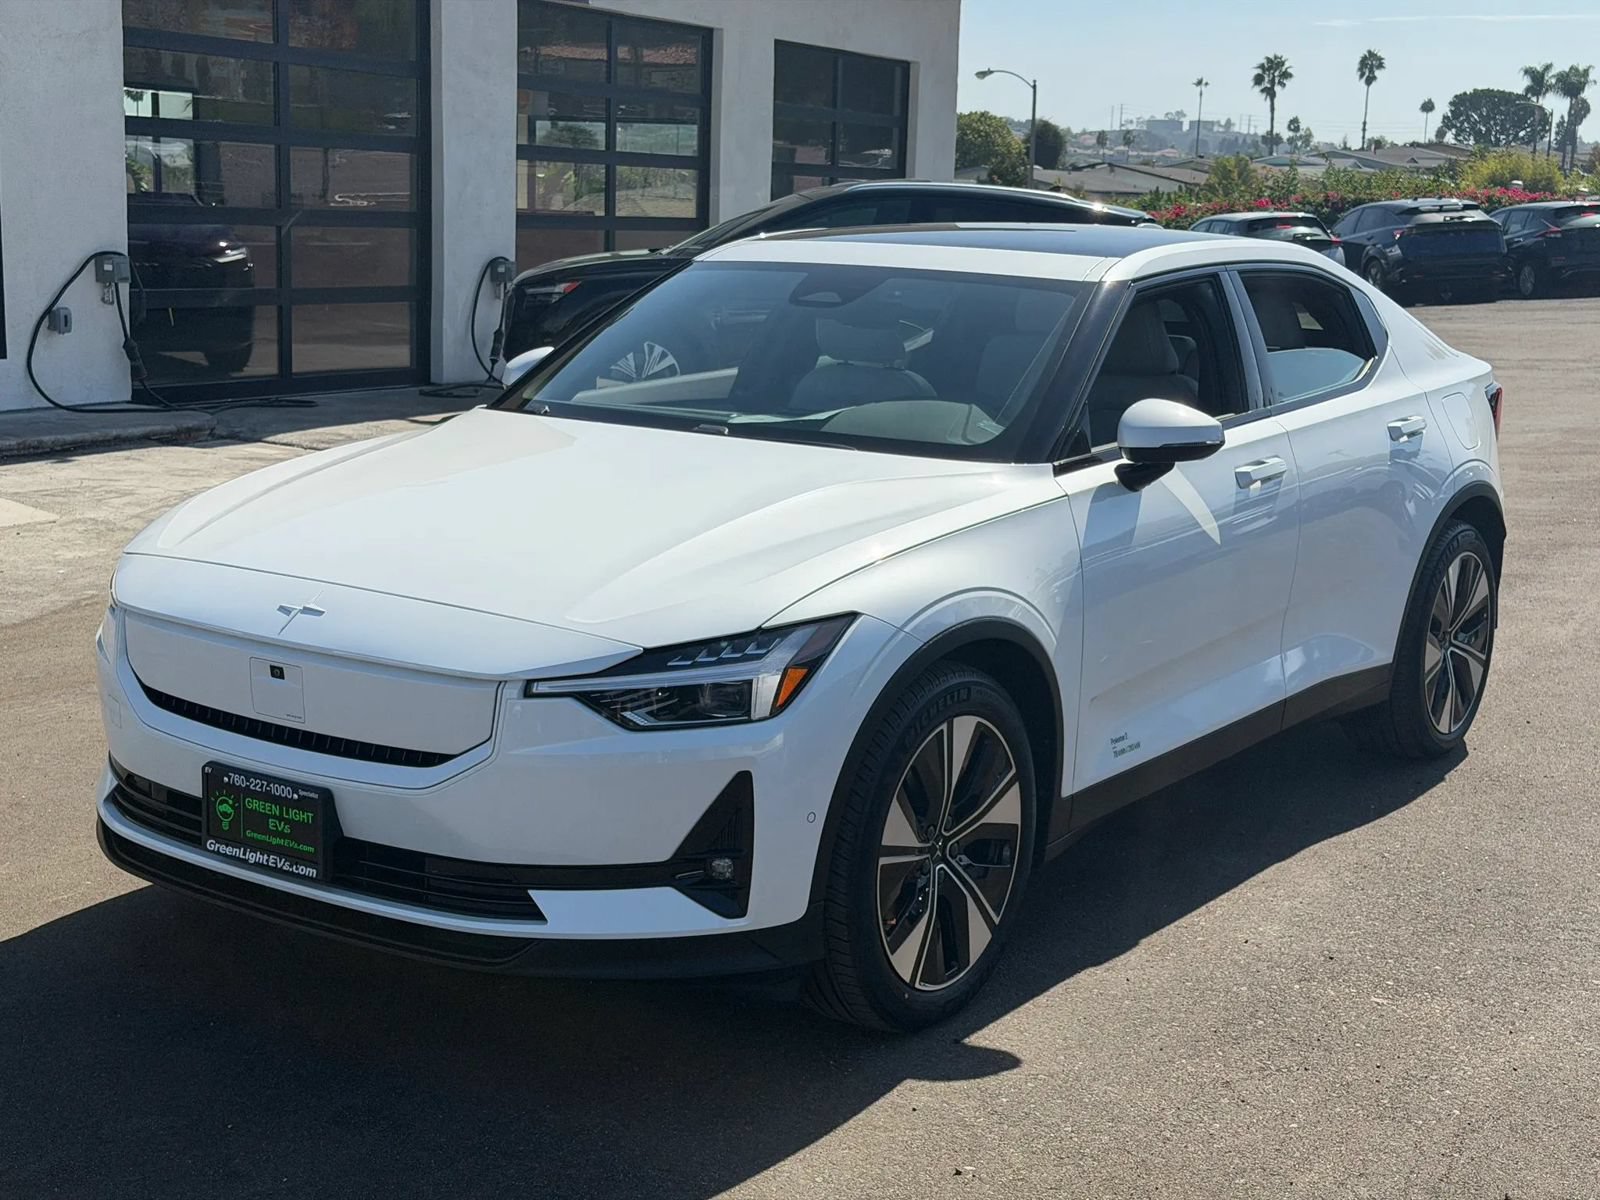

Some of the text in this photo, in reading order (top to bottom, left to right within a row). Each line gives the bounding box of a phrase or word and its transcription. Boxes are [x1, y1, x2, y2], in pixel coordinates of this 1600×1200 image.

[228, 773, 293, 799] 760-227-1000
[245, 798, 314, 824] GREEN LIGHT
[268, 819, 291, 833] EVs
[245, 830, 315, 853] GreenLightEVs.com
[206, 839, 318, 878] GreenLightEVs.com
